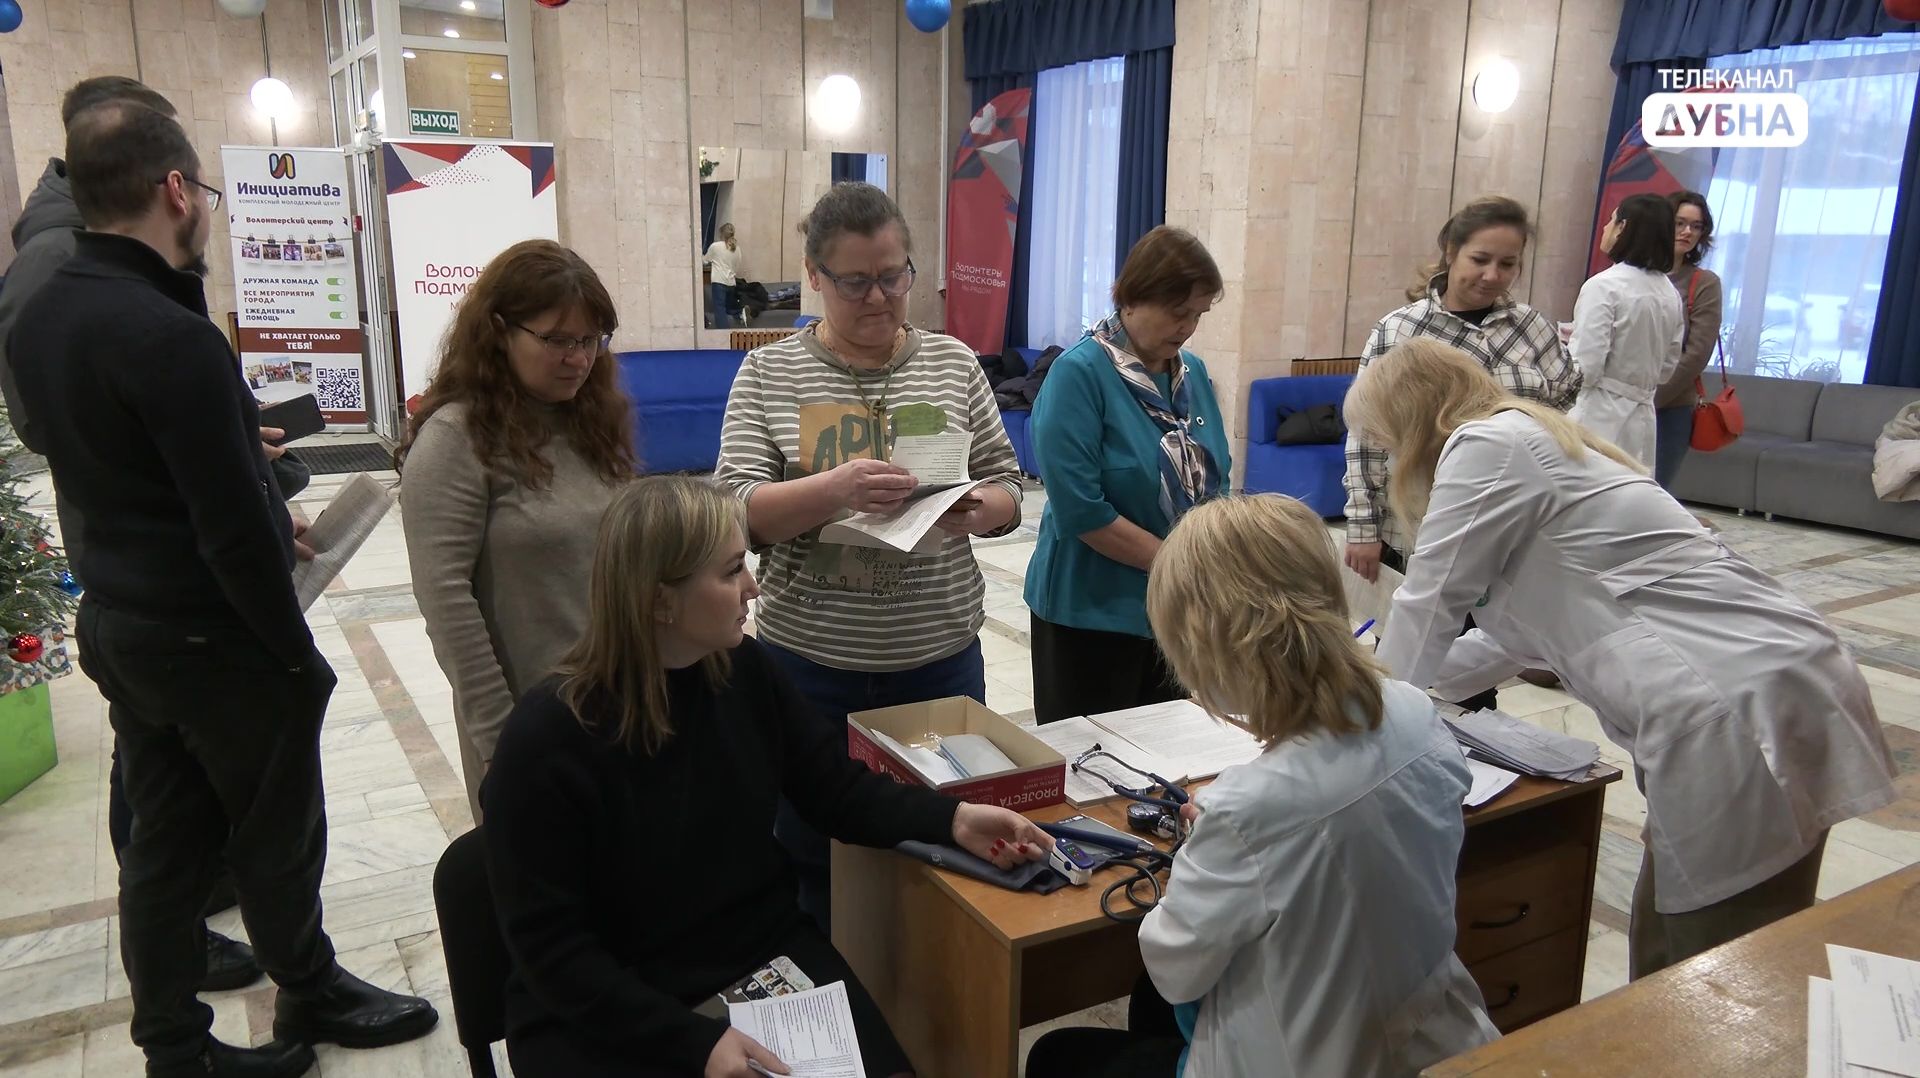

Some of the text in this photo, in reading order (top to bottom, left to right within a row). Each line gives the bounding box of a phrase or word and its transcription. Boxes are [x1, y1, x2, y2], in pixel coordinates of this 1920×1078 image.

[411, 112, 459, 131] ВЫХОД
[236, 182, 341, 198] Инициатива
[245, 216, 334, 226] Волонтерский центр
[259, 332, 341, 341] НЕ ХВАТАЕТ ТОЛЬКО
[286, 342, 313, 350] ТЕБЯ!
[1000, 786, 1059, 807] PROJECTA
